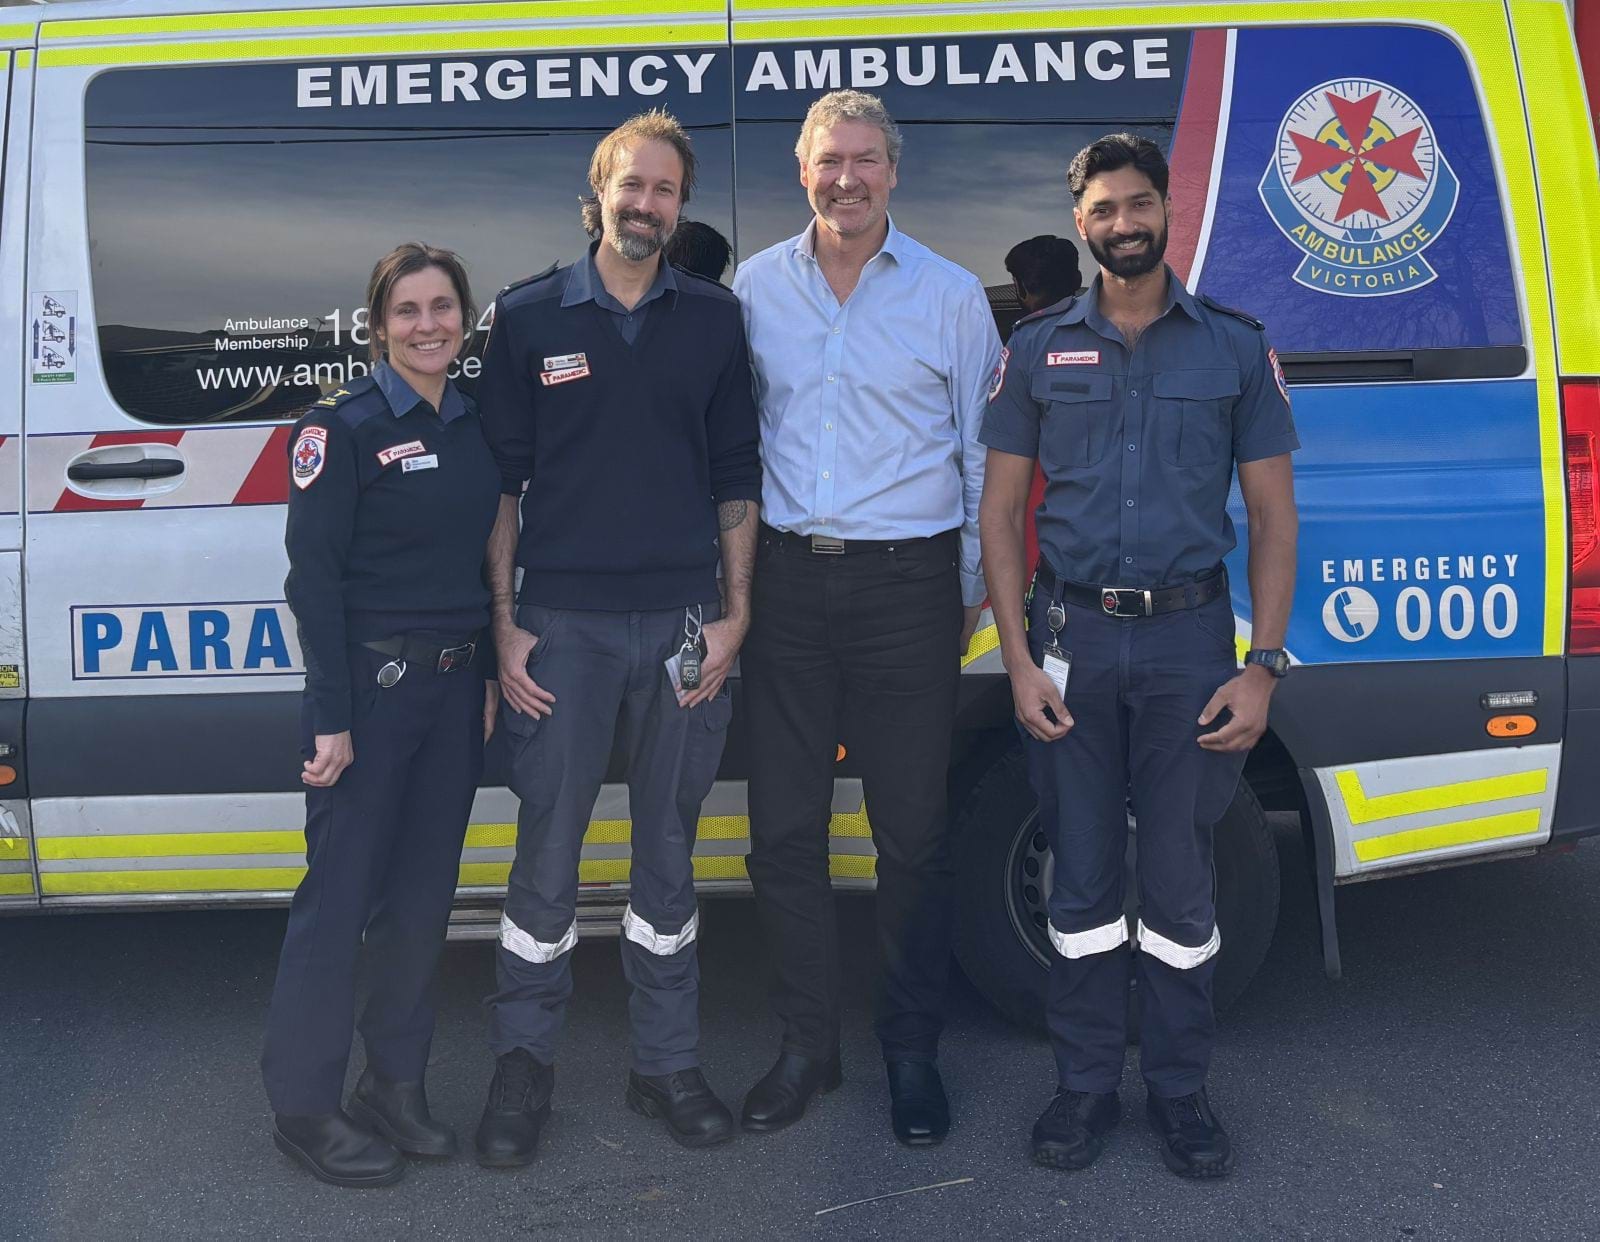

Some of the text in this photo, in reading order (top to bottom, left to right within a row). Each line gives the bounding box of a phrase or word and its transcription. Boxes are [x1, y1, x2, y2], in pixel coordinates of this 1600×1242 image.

[296, 37, 1171, 108] EMERGENCY AMBULANCE
[1290, 223, 1431, 265] AMBULANCE
[1311, 265, 1420, 287] VICTORIA
[224, 316, 309, 331] Ambulance
[215, 335, 309, 351] Membership
[552, 368, 587, 382] PARAMEDIC
[1322, 554, 1519, 583] EMERGENCY
[1395, 583, 1518, 641] 000
